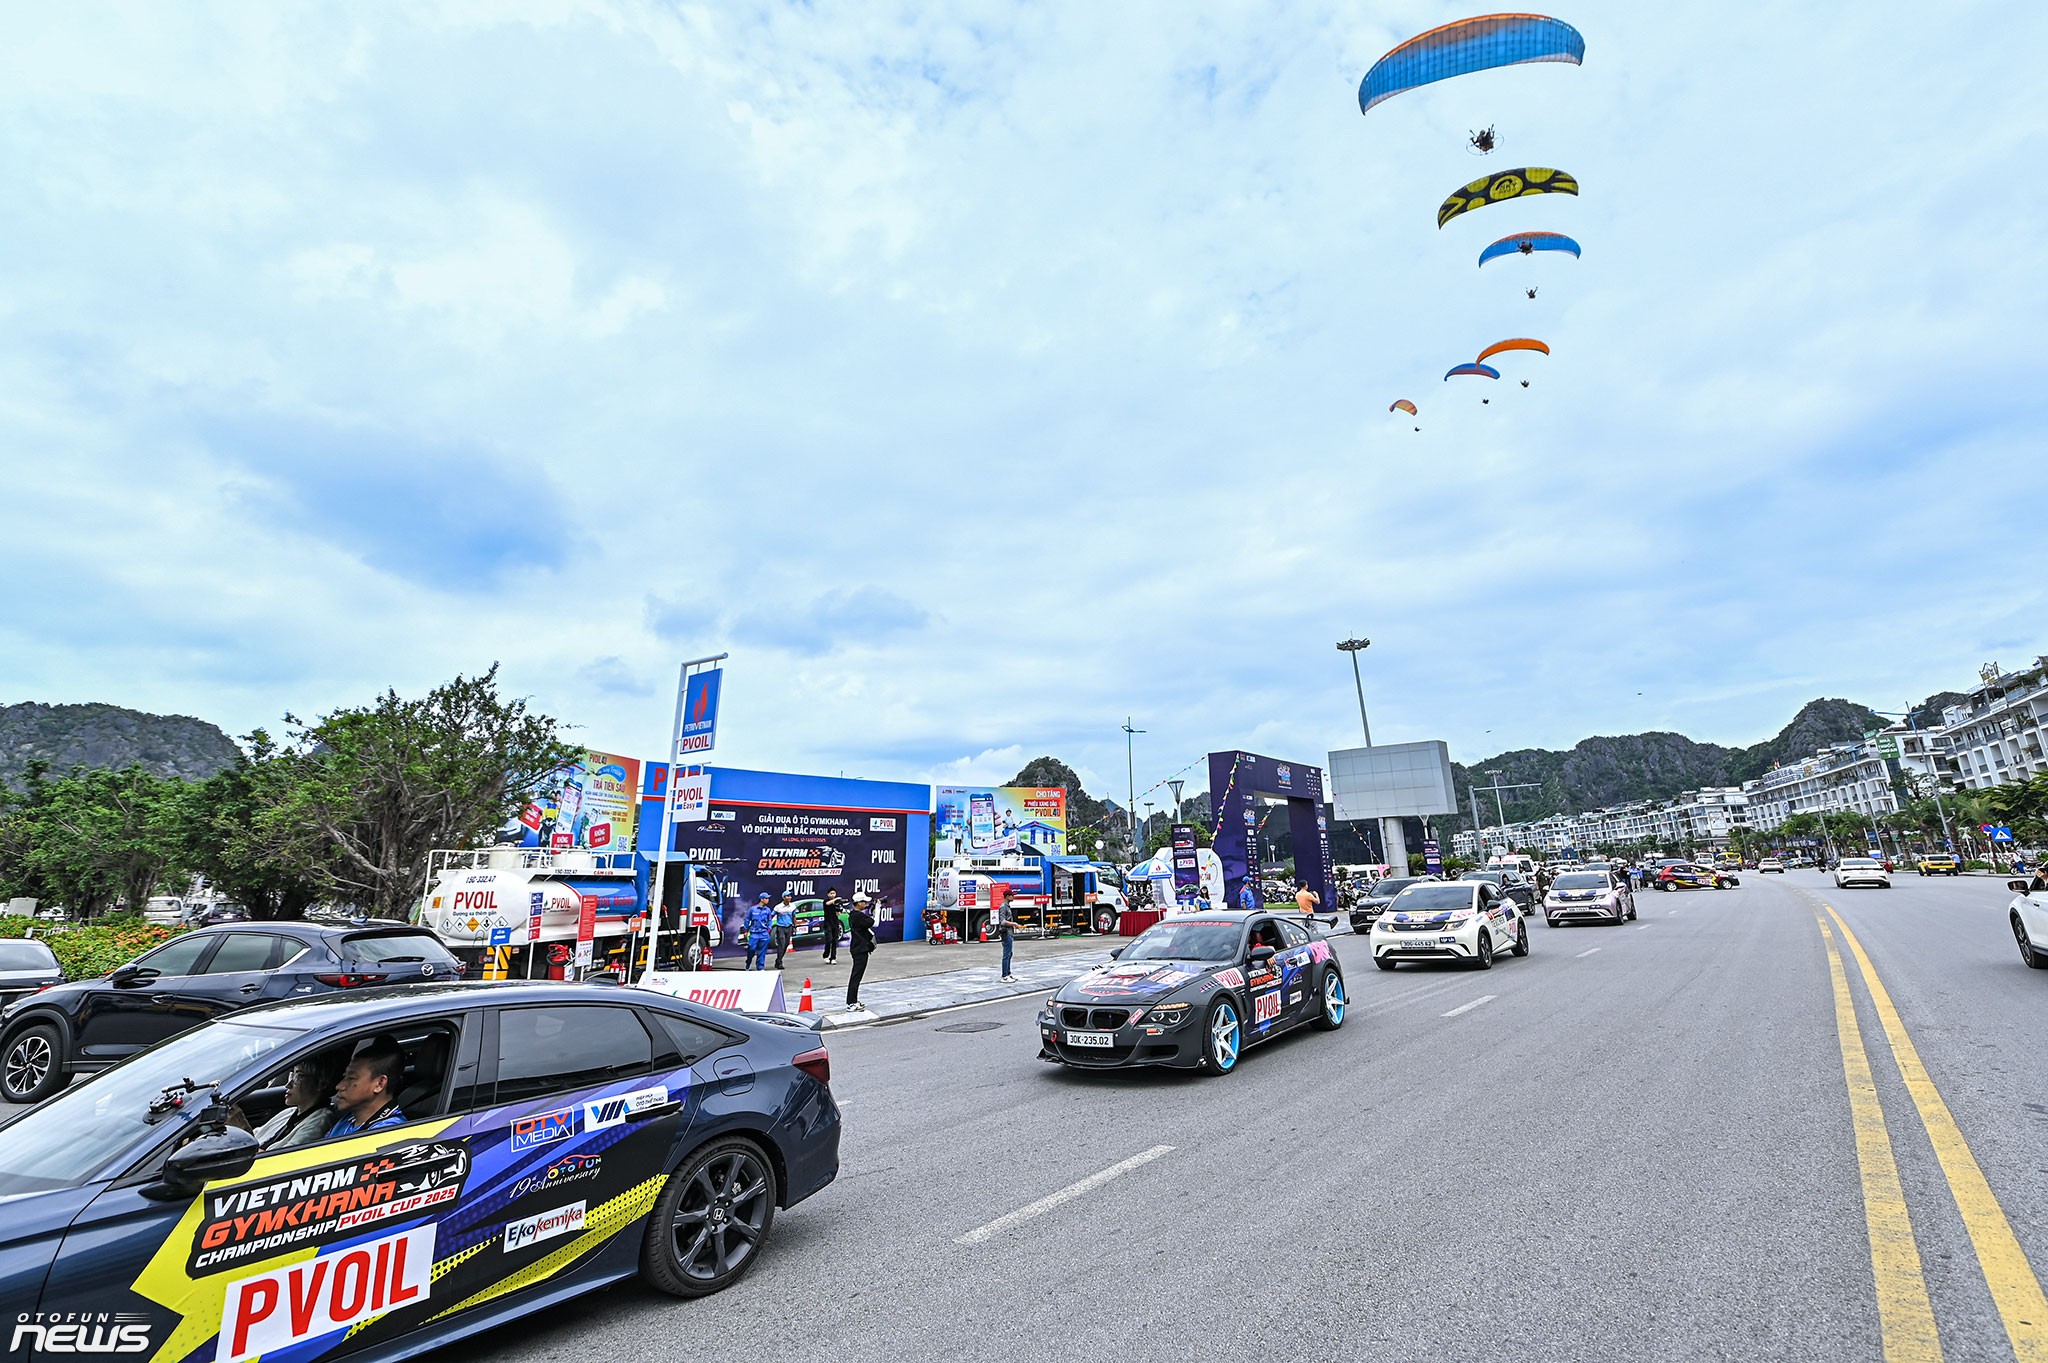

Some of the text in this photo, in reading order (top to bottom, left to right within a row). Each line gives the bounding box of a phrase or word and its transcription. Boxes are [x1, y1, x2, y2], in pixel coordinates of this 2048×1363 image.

[682, 735, 709, 751] PVOIL
[615, 783, 625, 792] SAU
[677, 787, 703, 802] PVOIL
[683, 802, 695, 811] Easy
[759, 813, 849, 826] GIẢI ĐUA Ô TÔ GYMKHANA
[880, 819, 894, 828] PVOIL
[742, 824, 753, 833] VÔ
[754, 825, 772, 835] ĐỊCH
[774, 824, 791, 834] MIỀN
[794, 824, 808, 835] BẮC
[809, 827, 829, 836] PVOIL
[762, 848, 808, 857] VIETNAM
[872, 850, 896, 863] PVOIL
[758, 858, 820, 869] GYMKHANA
[786, 880, 815, 895] PVOIL
[855, 879, 880, 893] PVOIL
[453, 891, 497, 909] PVOIL
[551, 898, 571, 909] PVOIL
[1215, 969, 1243, 986] PVOIL
[1256, 993, 1280, 1021] PVOIL
[1069, 1035, 1109, 1046] 30K-235.02
[516, 1112, 570, 1135] OTV
[516, 1126, 571, 1147] MEDIA
[547, 1157, 602, 1179] OTOFUN
[530, 1168, 600, 1192] Anniversary
[214, 1166, 357, 1218] VIETNAM
[201, 1181, 396, 1249] GYMKHANA
[195, 1187, 456, 1268] CHAMPIONSHIP PVOIL CUP 2025
[507, 1208, 583, 1246] Ekokemika
[231, 1237, 419, 1358] PVOIL
